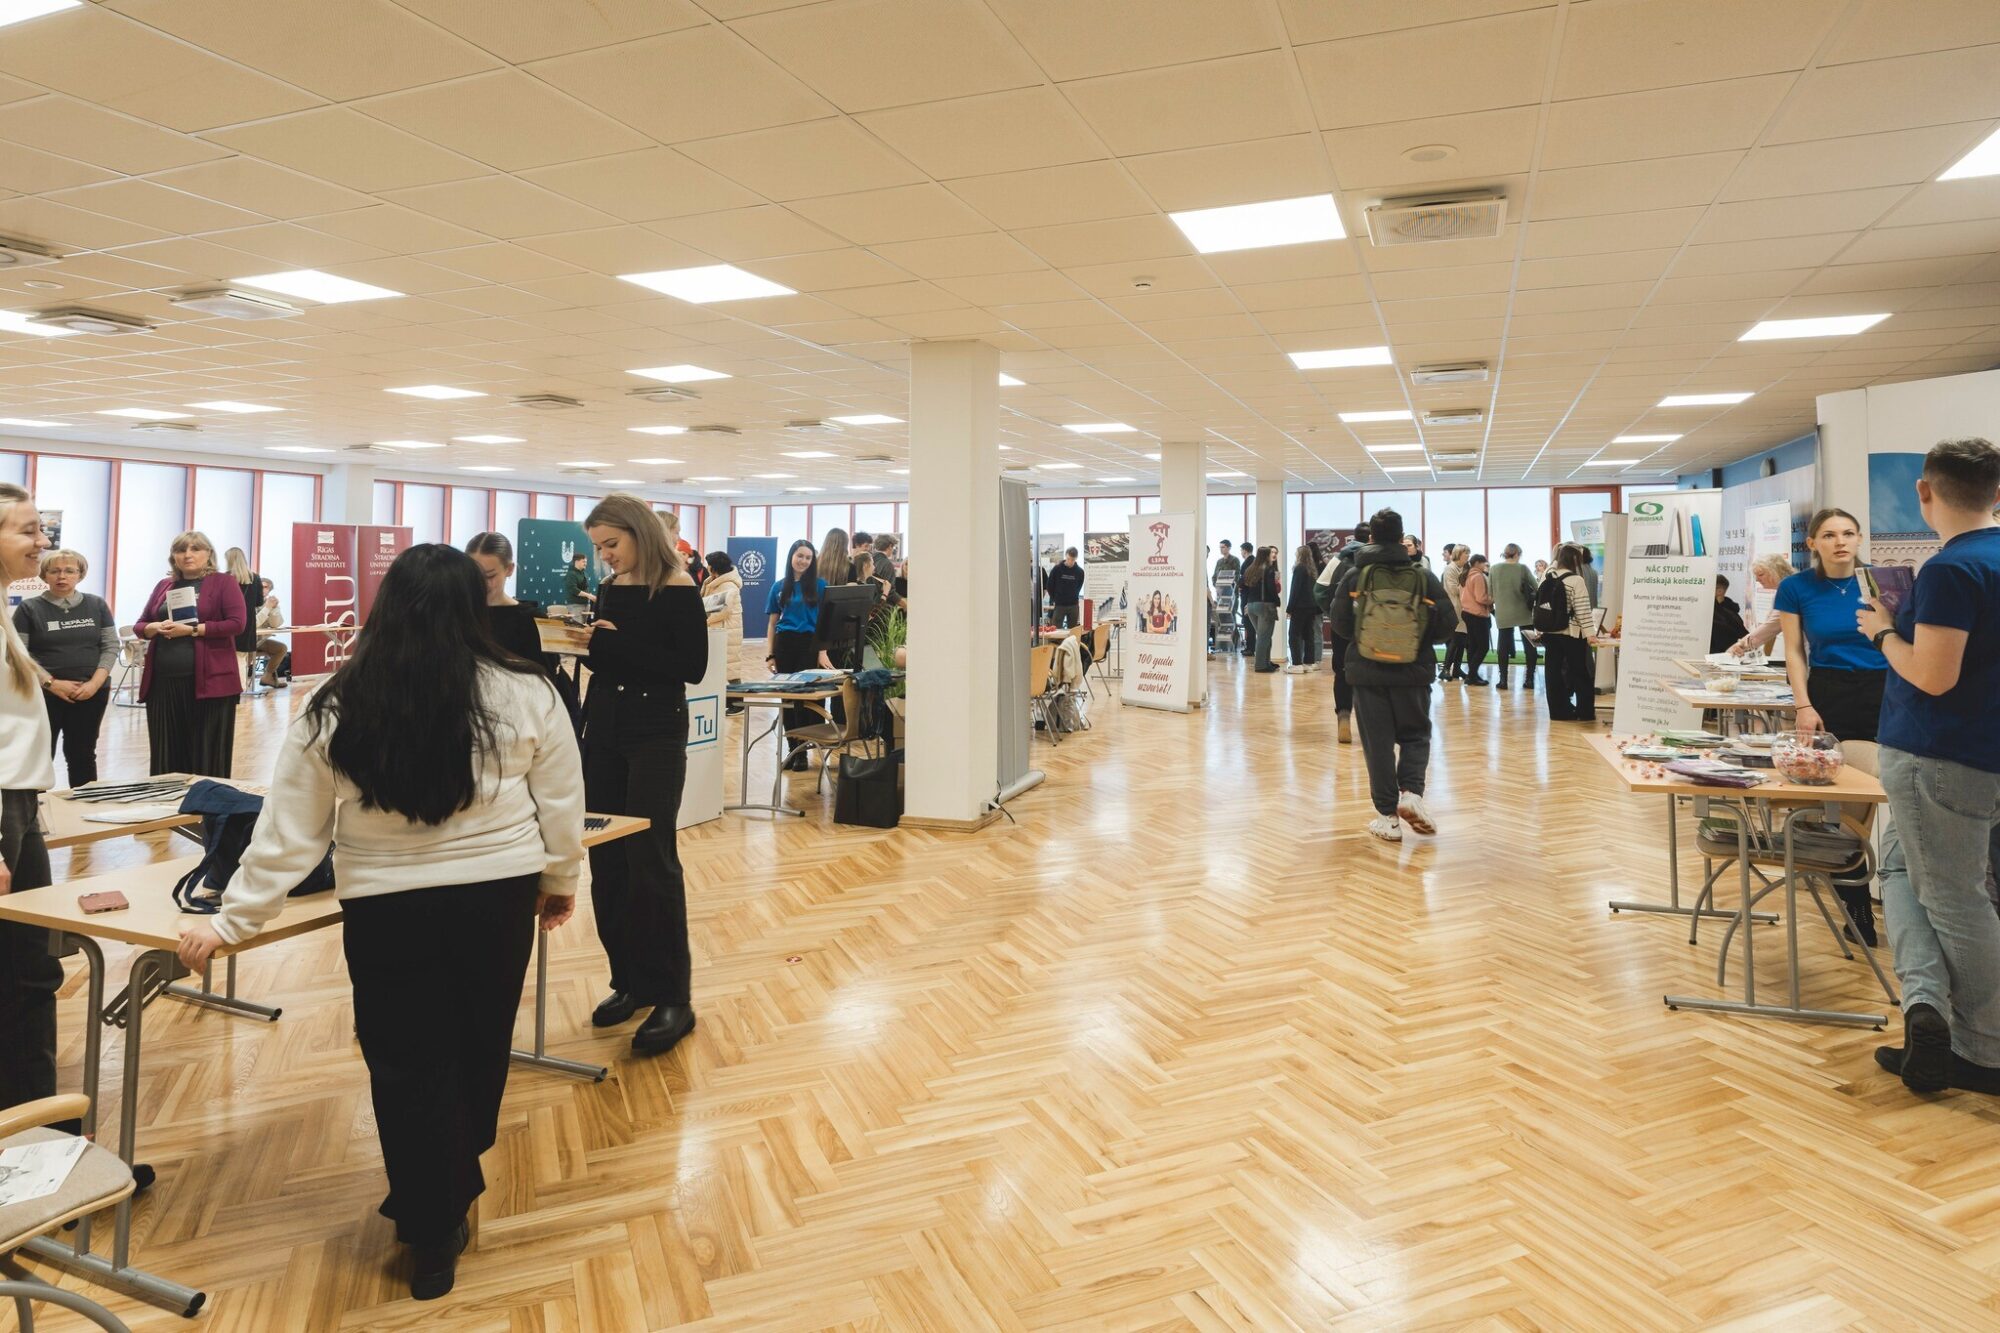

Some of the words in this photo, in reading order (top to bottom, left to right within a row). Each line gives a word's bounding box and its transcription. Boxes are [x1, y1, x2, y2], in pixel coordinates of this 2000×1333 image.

[317, 545, 335, 553] RĪGAS
[1645, 565, 1662, 573] NĀC
[1663, 564, 1690, 573] STUDĒT
[324, 572, 357, 667] RSU
[1137, 653, 1153, 665] 100
[694, 714, 713, 736] Tu
